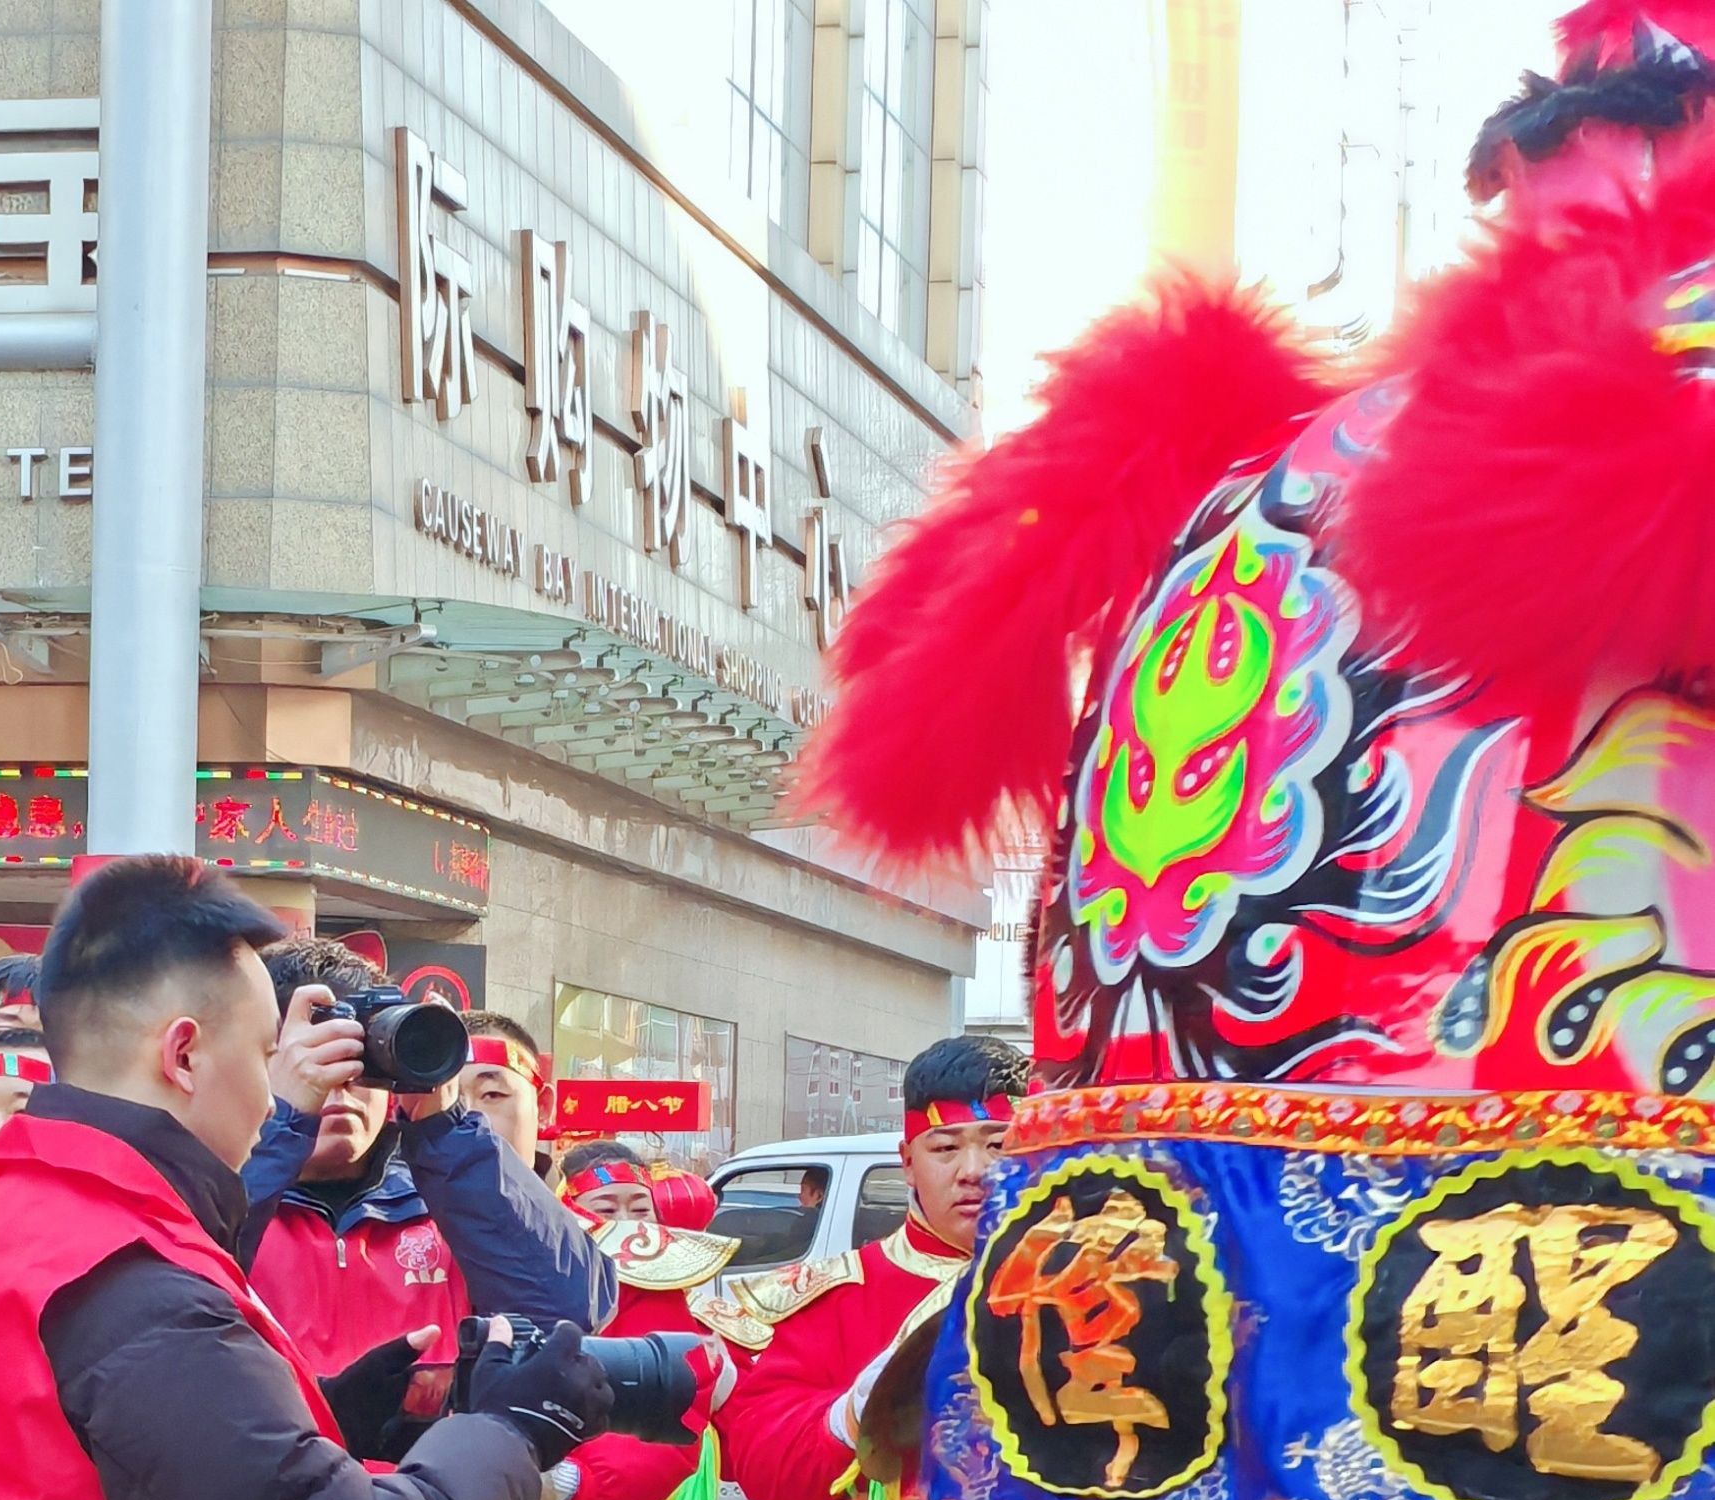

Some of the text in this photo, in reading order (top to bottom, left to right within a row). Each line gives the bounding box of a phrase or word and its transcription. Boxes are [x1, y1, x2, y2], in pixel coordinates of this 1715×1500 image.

[414, 477, 526, 580] CAUSEWAY
[535, 543, 578, 606] BAY
[584, 570, 716, 682] INTERNATIONAL
[604, 1096, 685, 1115] 腊八节
